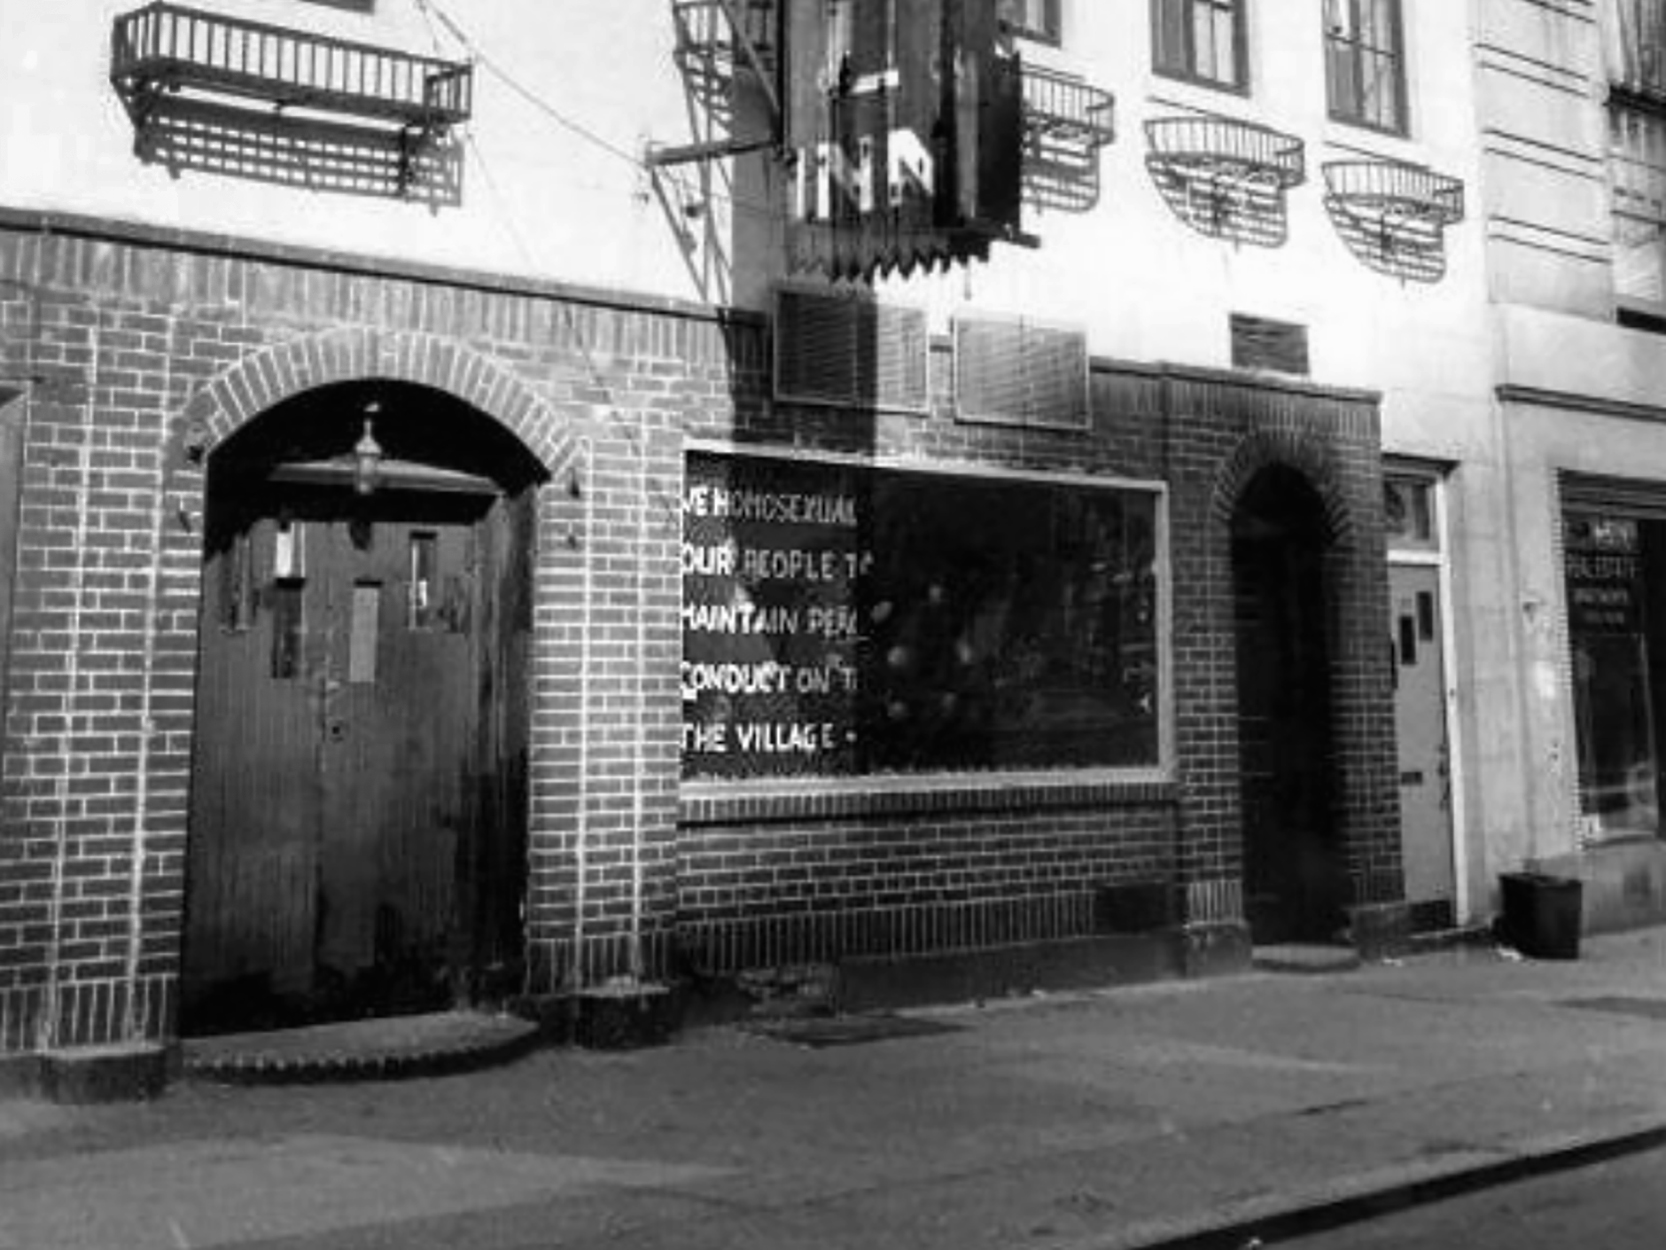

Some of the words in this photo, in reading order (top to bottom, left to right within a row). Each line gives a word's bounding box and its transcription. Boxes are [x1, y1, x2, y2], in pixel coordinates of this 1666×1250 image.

[795, 128, 935, 220] INN
[681, 543, 734, 576] OUR
[744, 549, 834, 581] PEOPLE
[681, 661, 790, 694] CONDUCT
[796, 666, 830, 694] ON
[681, 722, 727, 753] THE
[735, 722, 834, 753] VILLAGE
